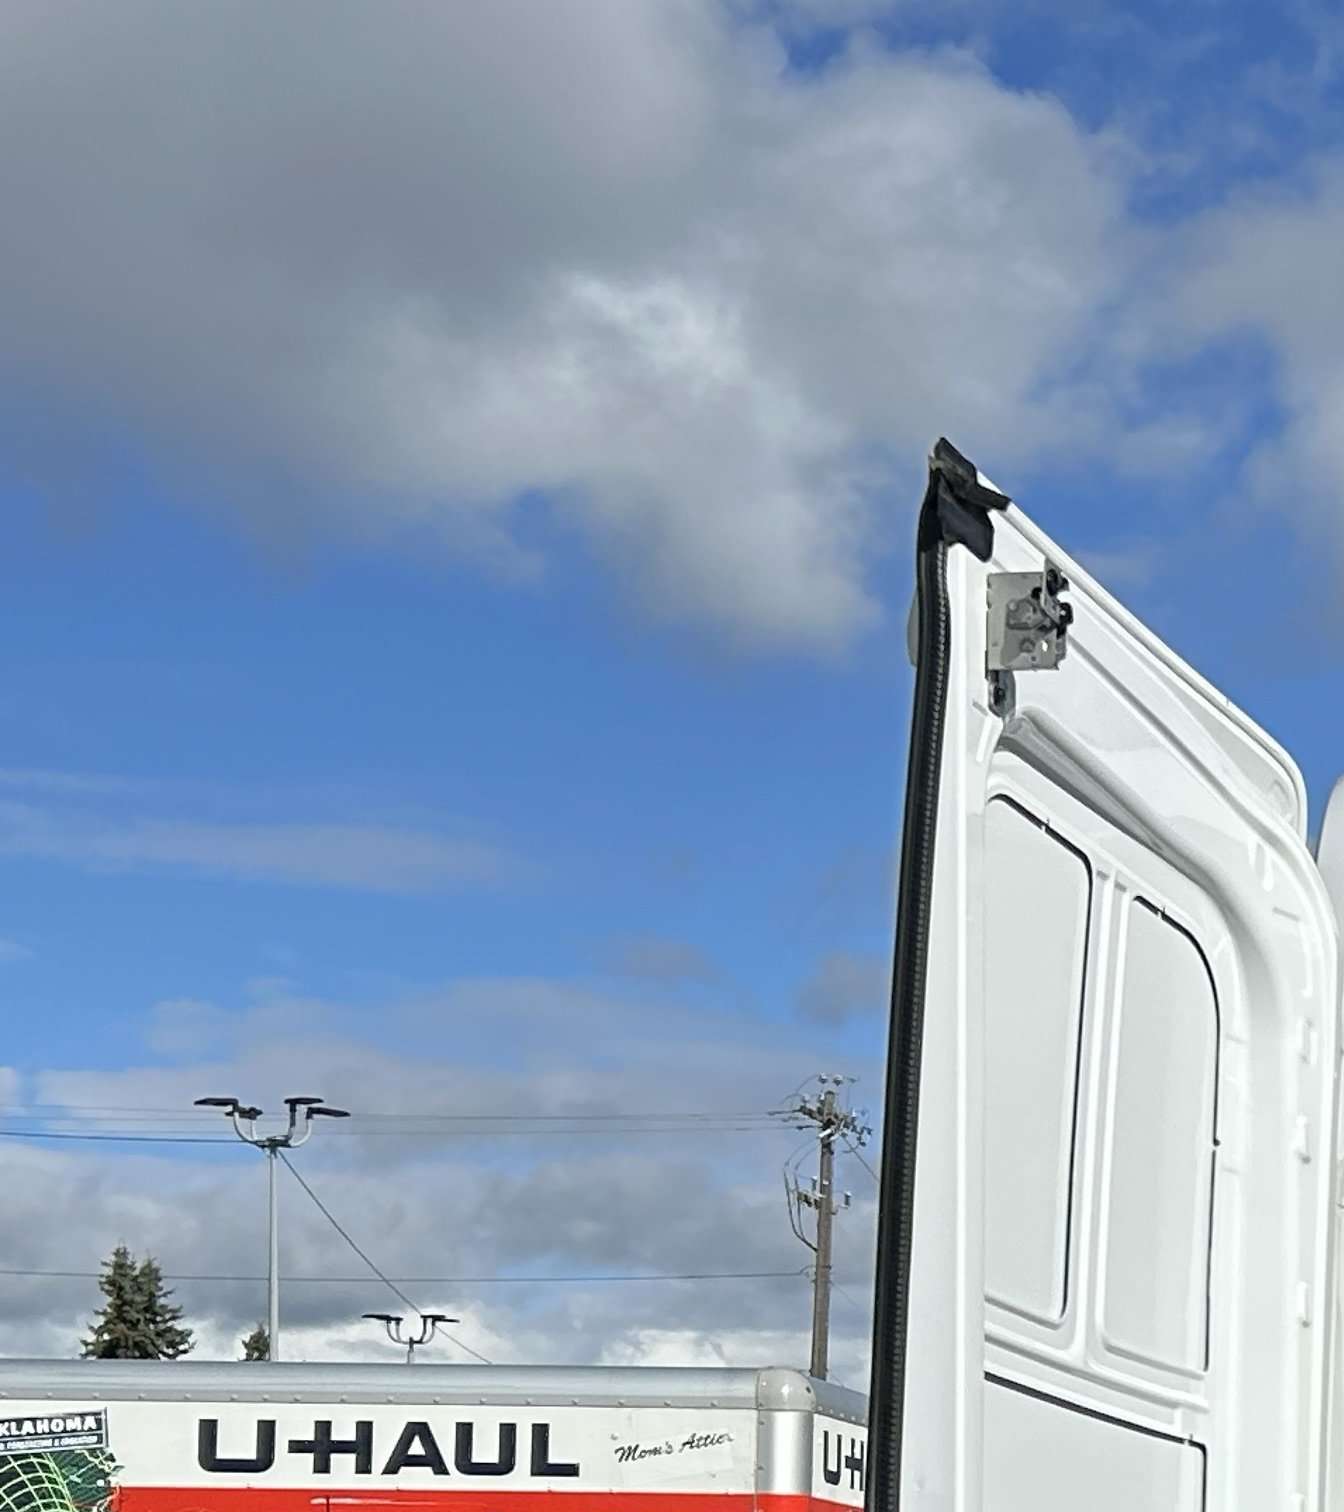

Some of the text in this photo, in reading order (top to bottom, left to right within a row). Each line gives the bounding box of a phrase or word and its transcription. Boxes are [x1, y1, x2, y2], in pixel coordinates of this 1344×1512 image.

[0, 1416, 97, 1437] KLAHOMA
[198, 1419, 580, 1477] U-HAUL
[614, 1444, 674, 1463] Mom's
[823, 1430, 864, 1491] U-H
